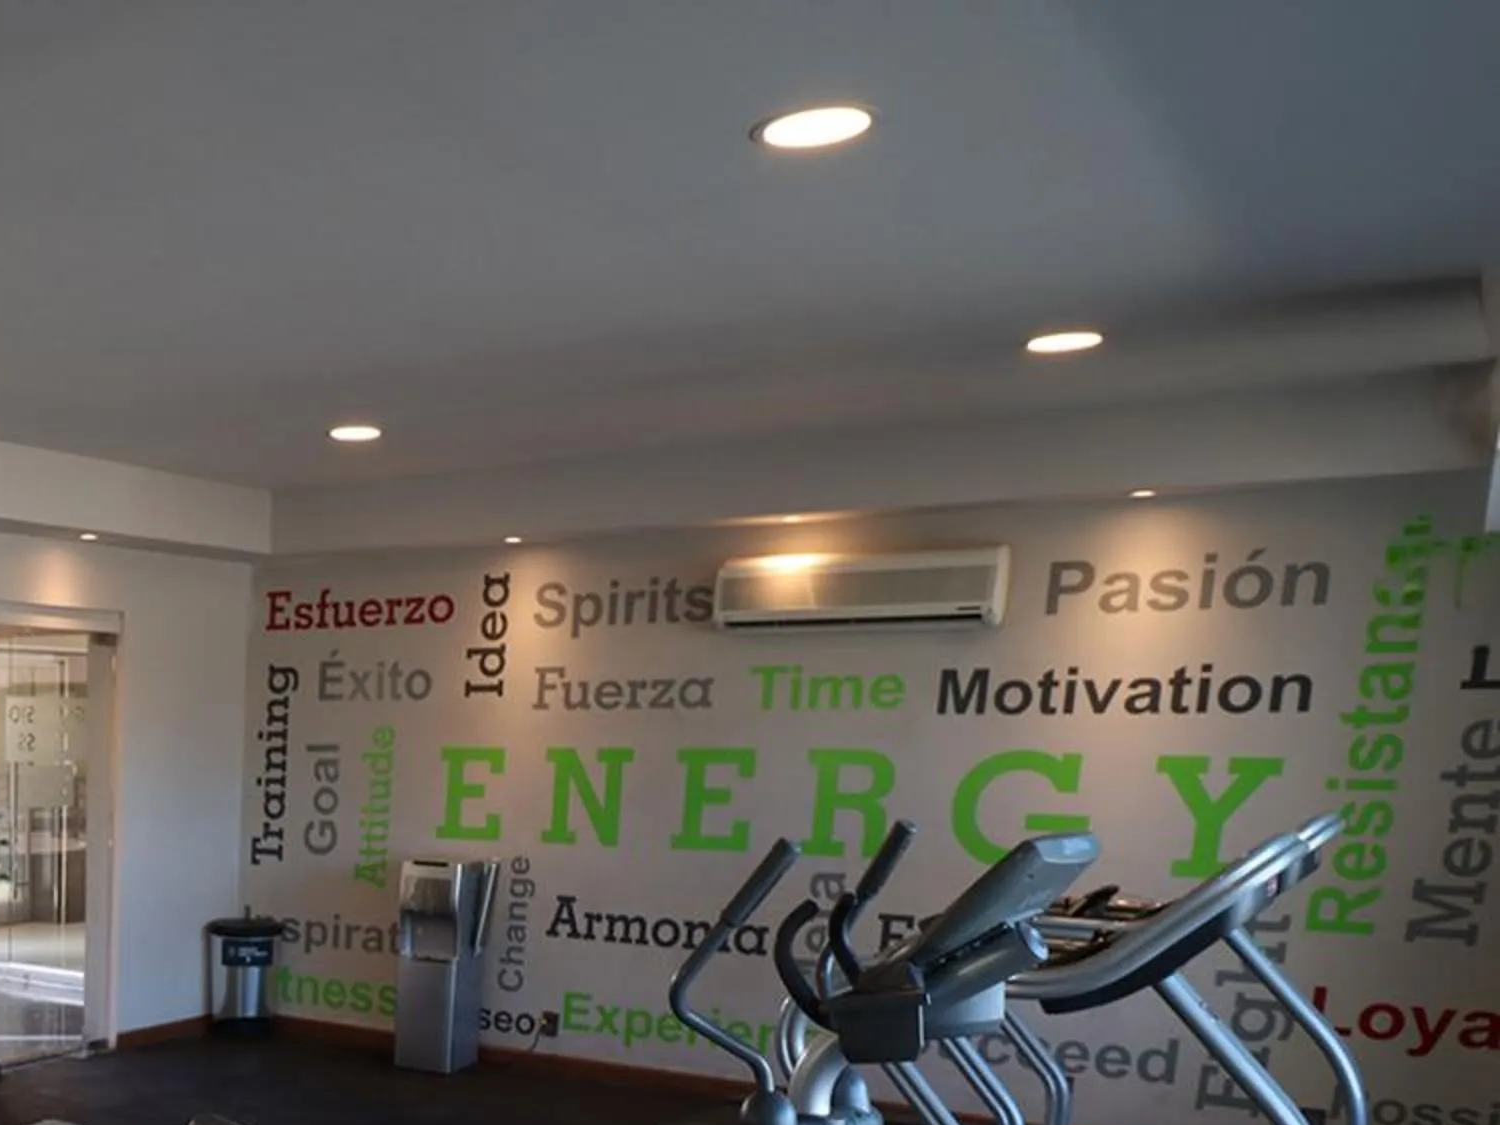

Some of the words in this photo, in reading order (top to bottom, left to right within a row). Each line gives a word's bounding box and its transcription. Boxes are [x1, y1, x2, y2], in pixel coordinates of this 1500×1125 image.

[265, 589, 455, 631] Esfuerzo
[532, 576, 715, 639] Spirits
[1045, 548, 1331, 616] Pasión
[464, 572, 511, 698] Idea
[317, 650, 432, 702] Éxito
[532, 666, 716, 712] Fuerza
[749, 664, 906, 712] Time
[936, 664, 1314, 716] Motivation
[1305, 514, 1431, 937] Resistan
[251, 663, 299, 865] Training
[303, 743, 341, 856] Goal
[354, 724, 396, 890] Attitude
[436, 746, 1284, 879] ENERGY
[1404, 718, 1500, 947] Mente
[244, 905, 399, 954] spirat
[497, 855, 535, 993] Change
[545, 895, 770, 956] Armona
